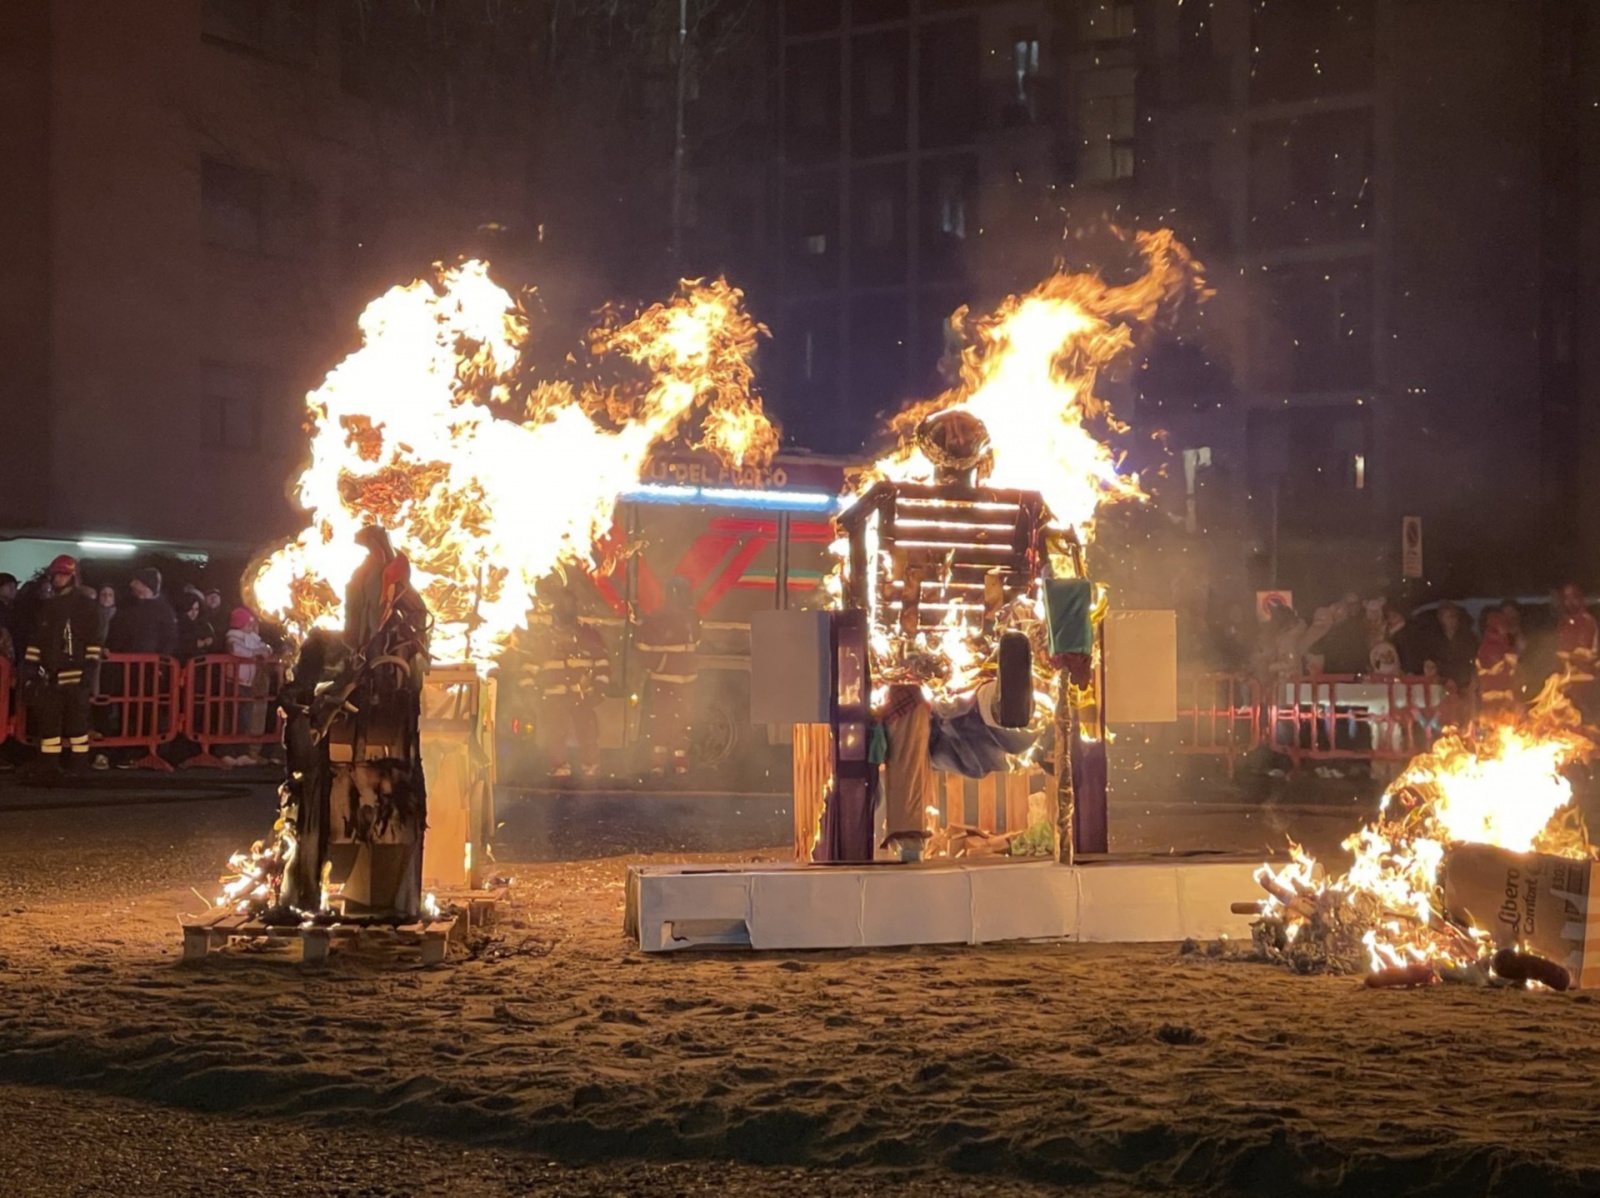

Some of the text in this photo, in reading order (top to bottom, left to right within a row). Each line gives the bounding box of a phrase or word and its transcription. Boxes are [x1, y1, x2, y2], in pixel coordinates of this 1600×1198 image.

[676, 463, 714, 484] DEL
[1498, 867, 1521, 935] Libero
[1523, 878, 1538, 935] Comfort
